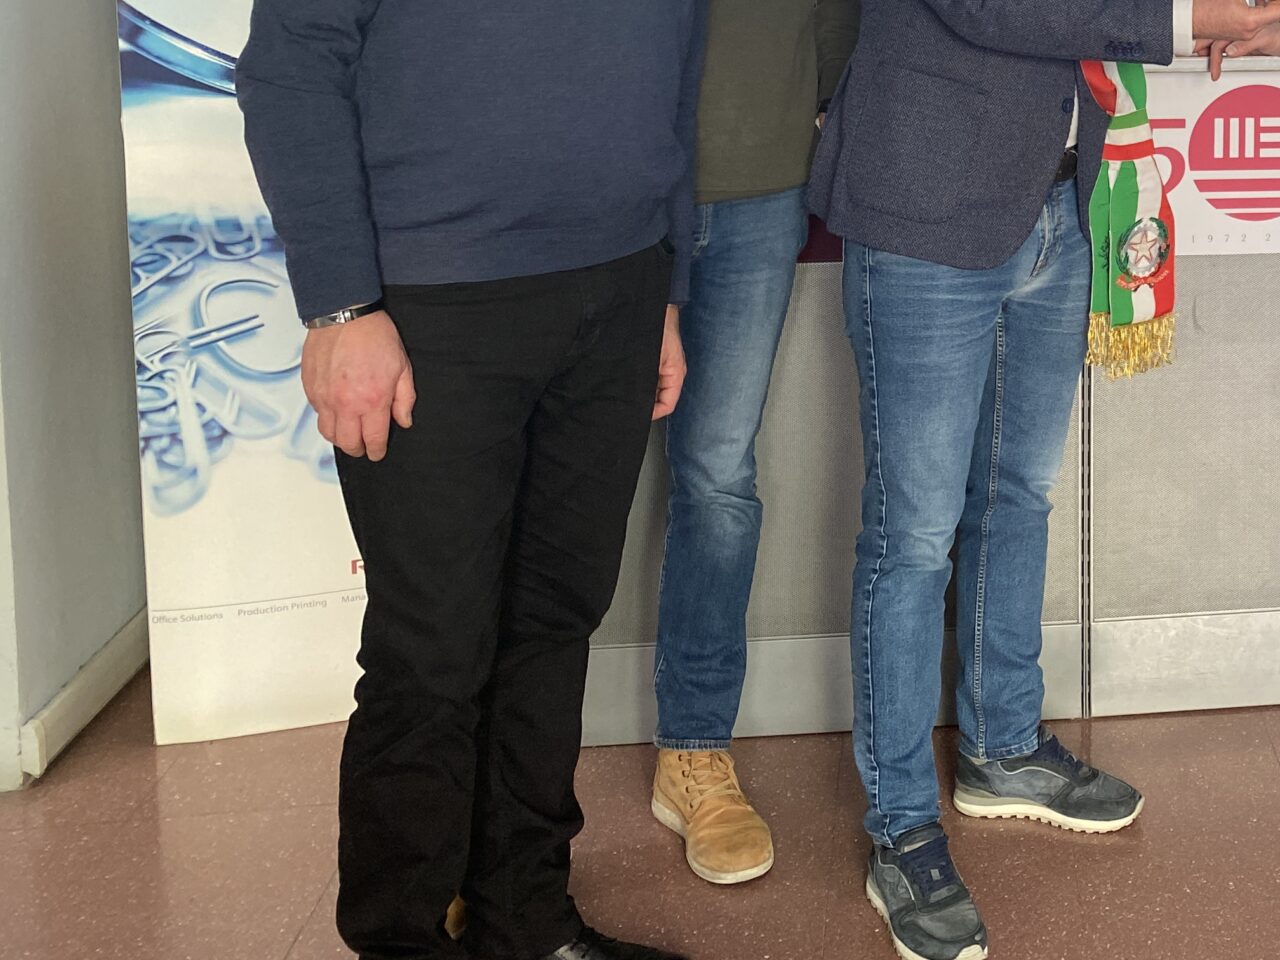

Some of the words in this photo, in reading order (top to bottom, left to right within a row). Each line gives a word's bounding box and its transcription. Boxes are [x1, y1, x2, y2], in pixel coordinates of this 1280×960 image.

[237, 604, 289, 617] Production
[291, 599, 328, 611] Printing
[152, 615, 179, 624] Office
[180, 612, 224, 623] Solutions
